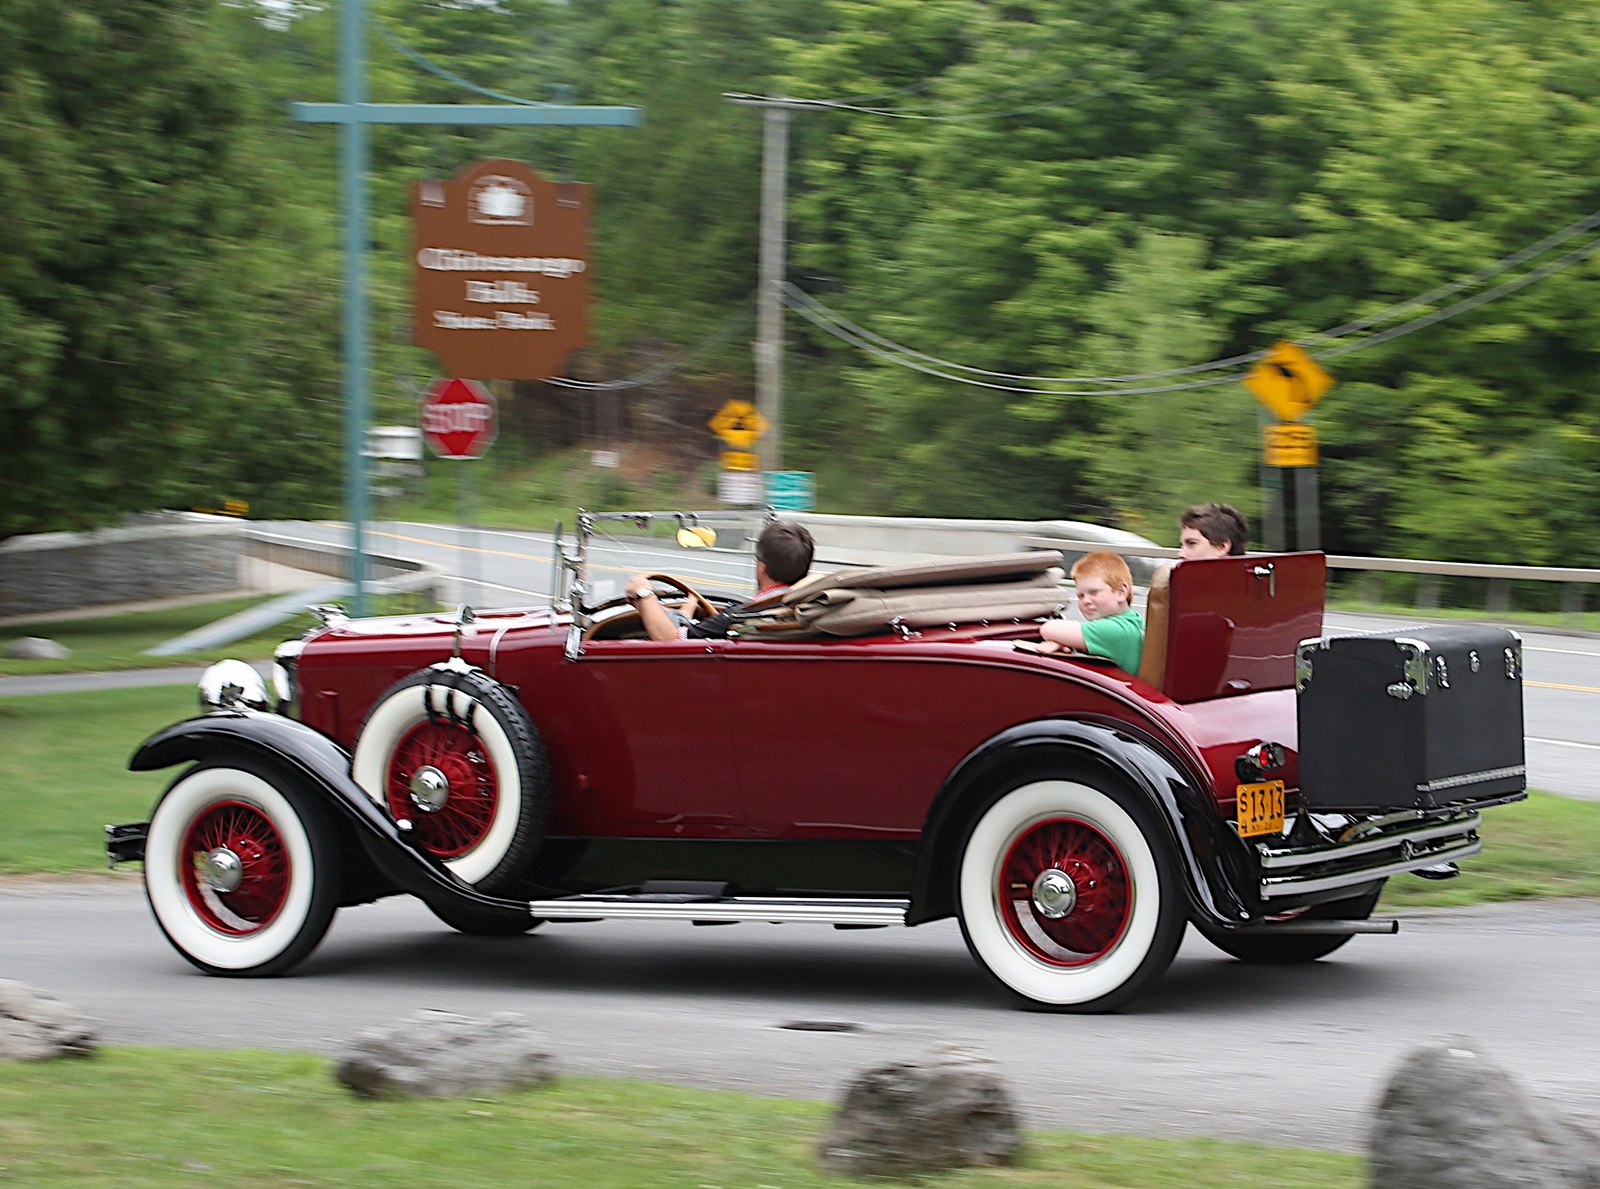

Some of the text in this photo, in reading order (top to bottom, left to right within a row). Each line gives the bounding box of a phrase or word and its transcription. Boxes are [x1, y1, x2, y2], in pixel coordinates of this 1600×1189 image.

[464, 280, 541, 304] Falls
[433, 309, 556, 331] State Park
[422, 402, 493, 434] STOP
